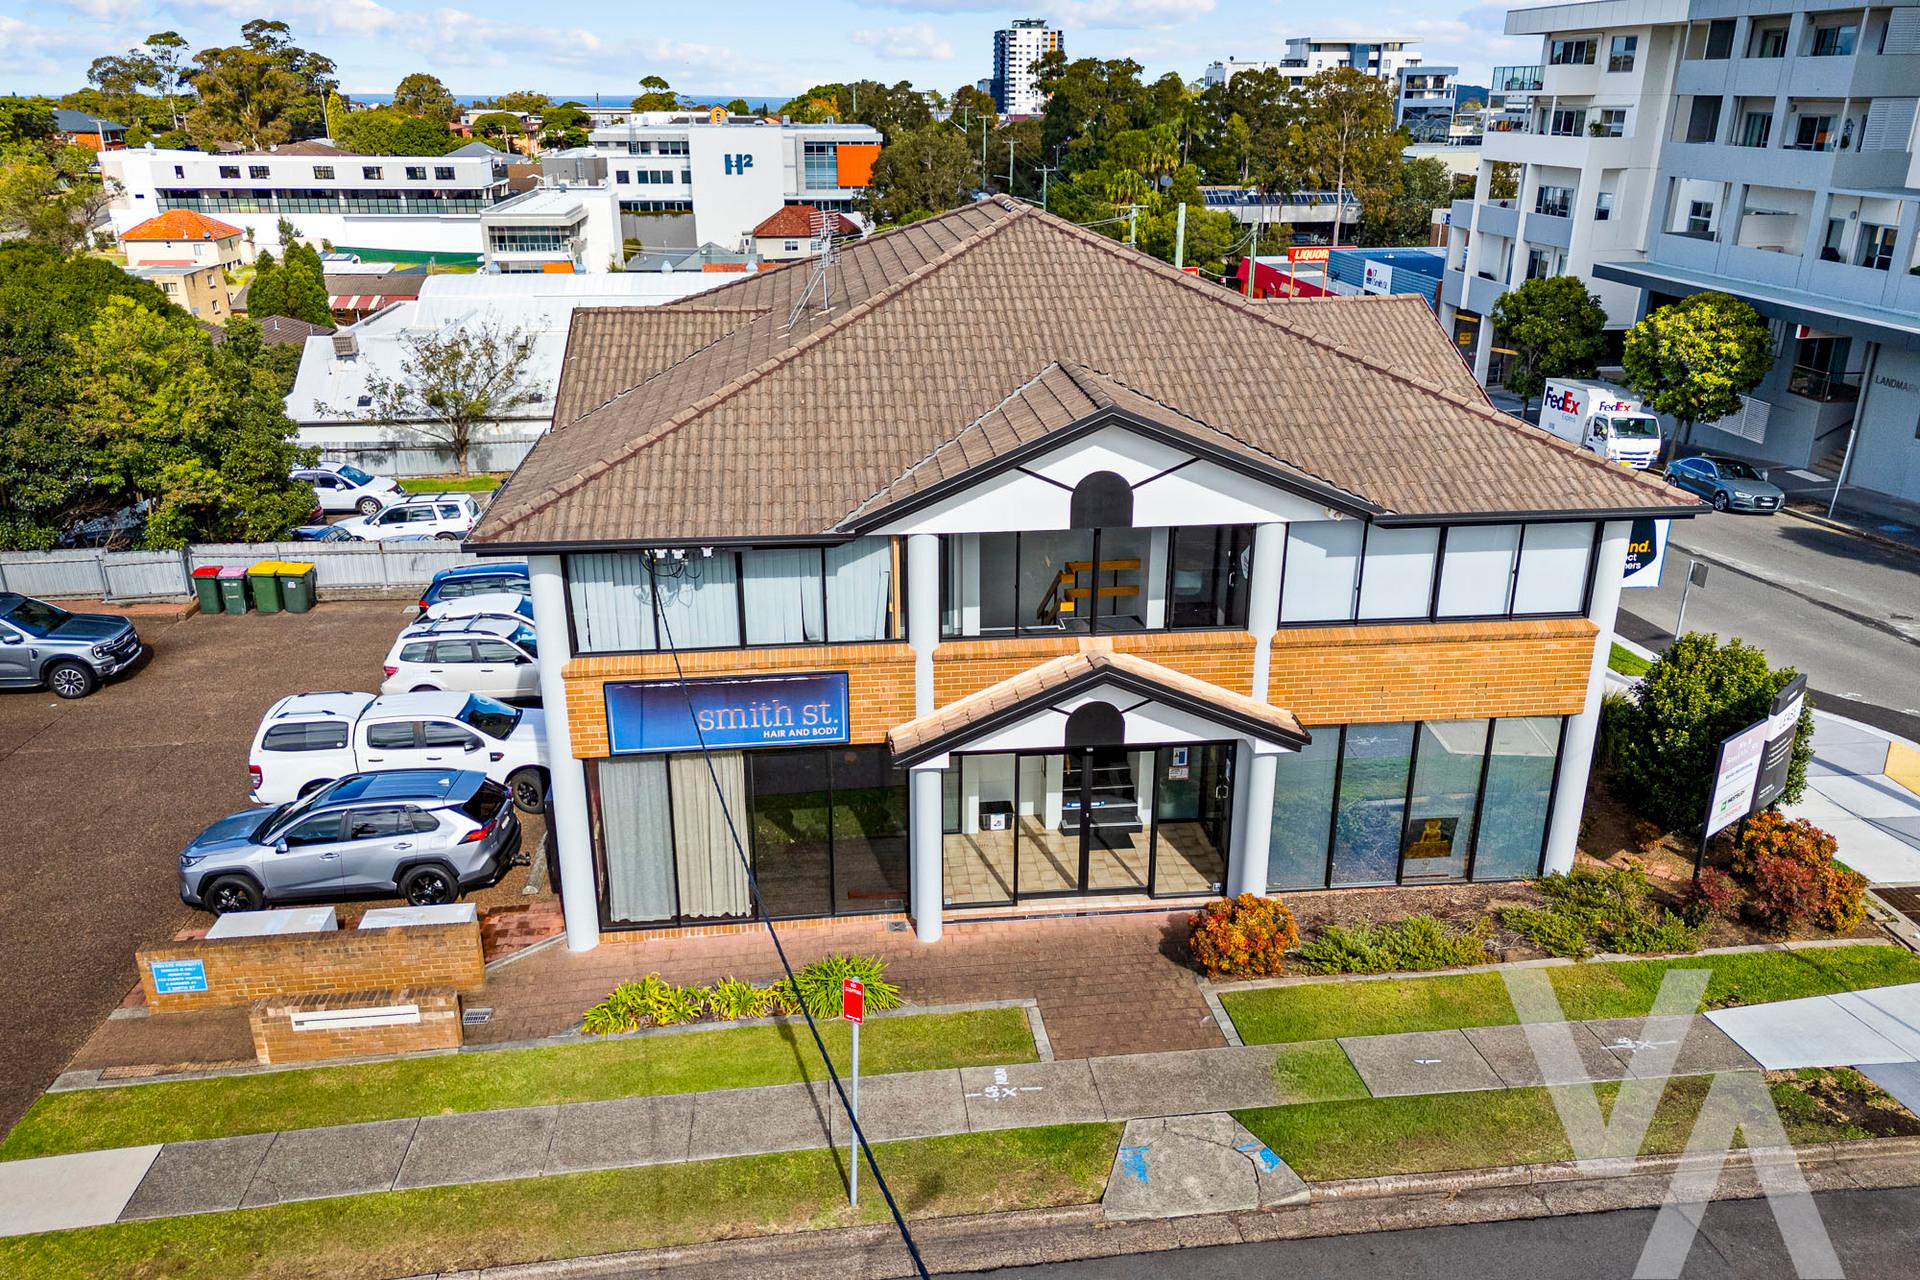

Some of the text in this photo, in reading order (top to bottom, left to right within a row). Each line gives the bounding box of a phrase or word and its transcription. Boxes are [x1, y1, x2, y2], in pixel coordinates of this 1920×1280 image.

[1544, 386, 1580, 415] FedEx
[1599, 401, 1631, 412] FedEx
[698, 699, 839, 731] smith st.
[763, 727, 838, 738] HAIR AND BODY
